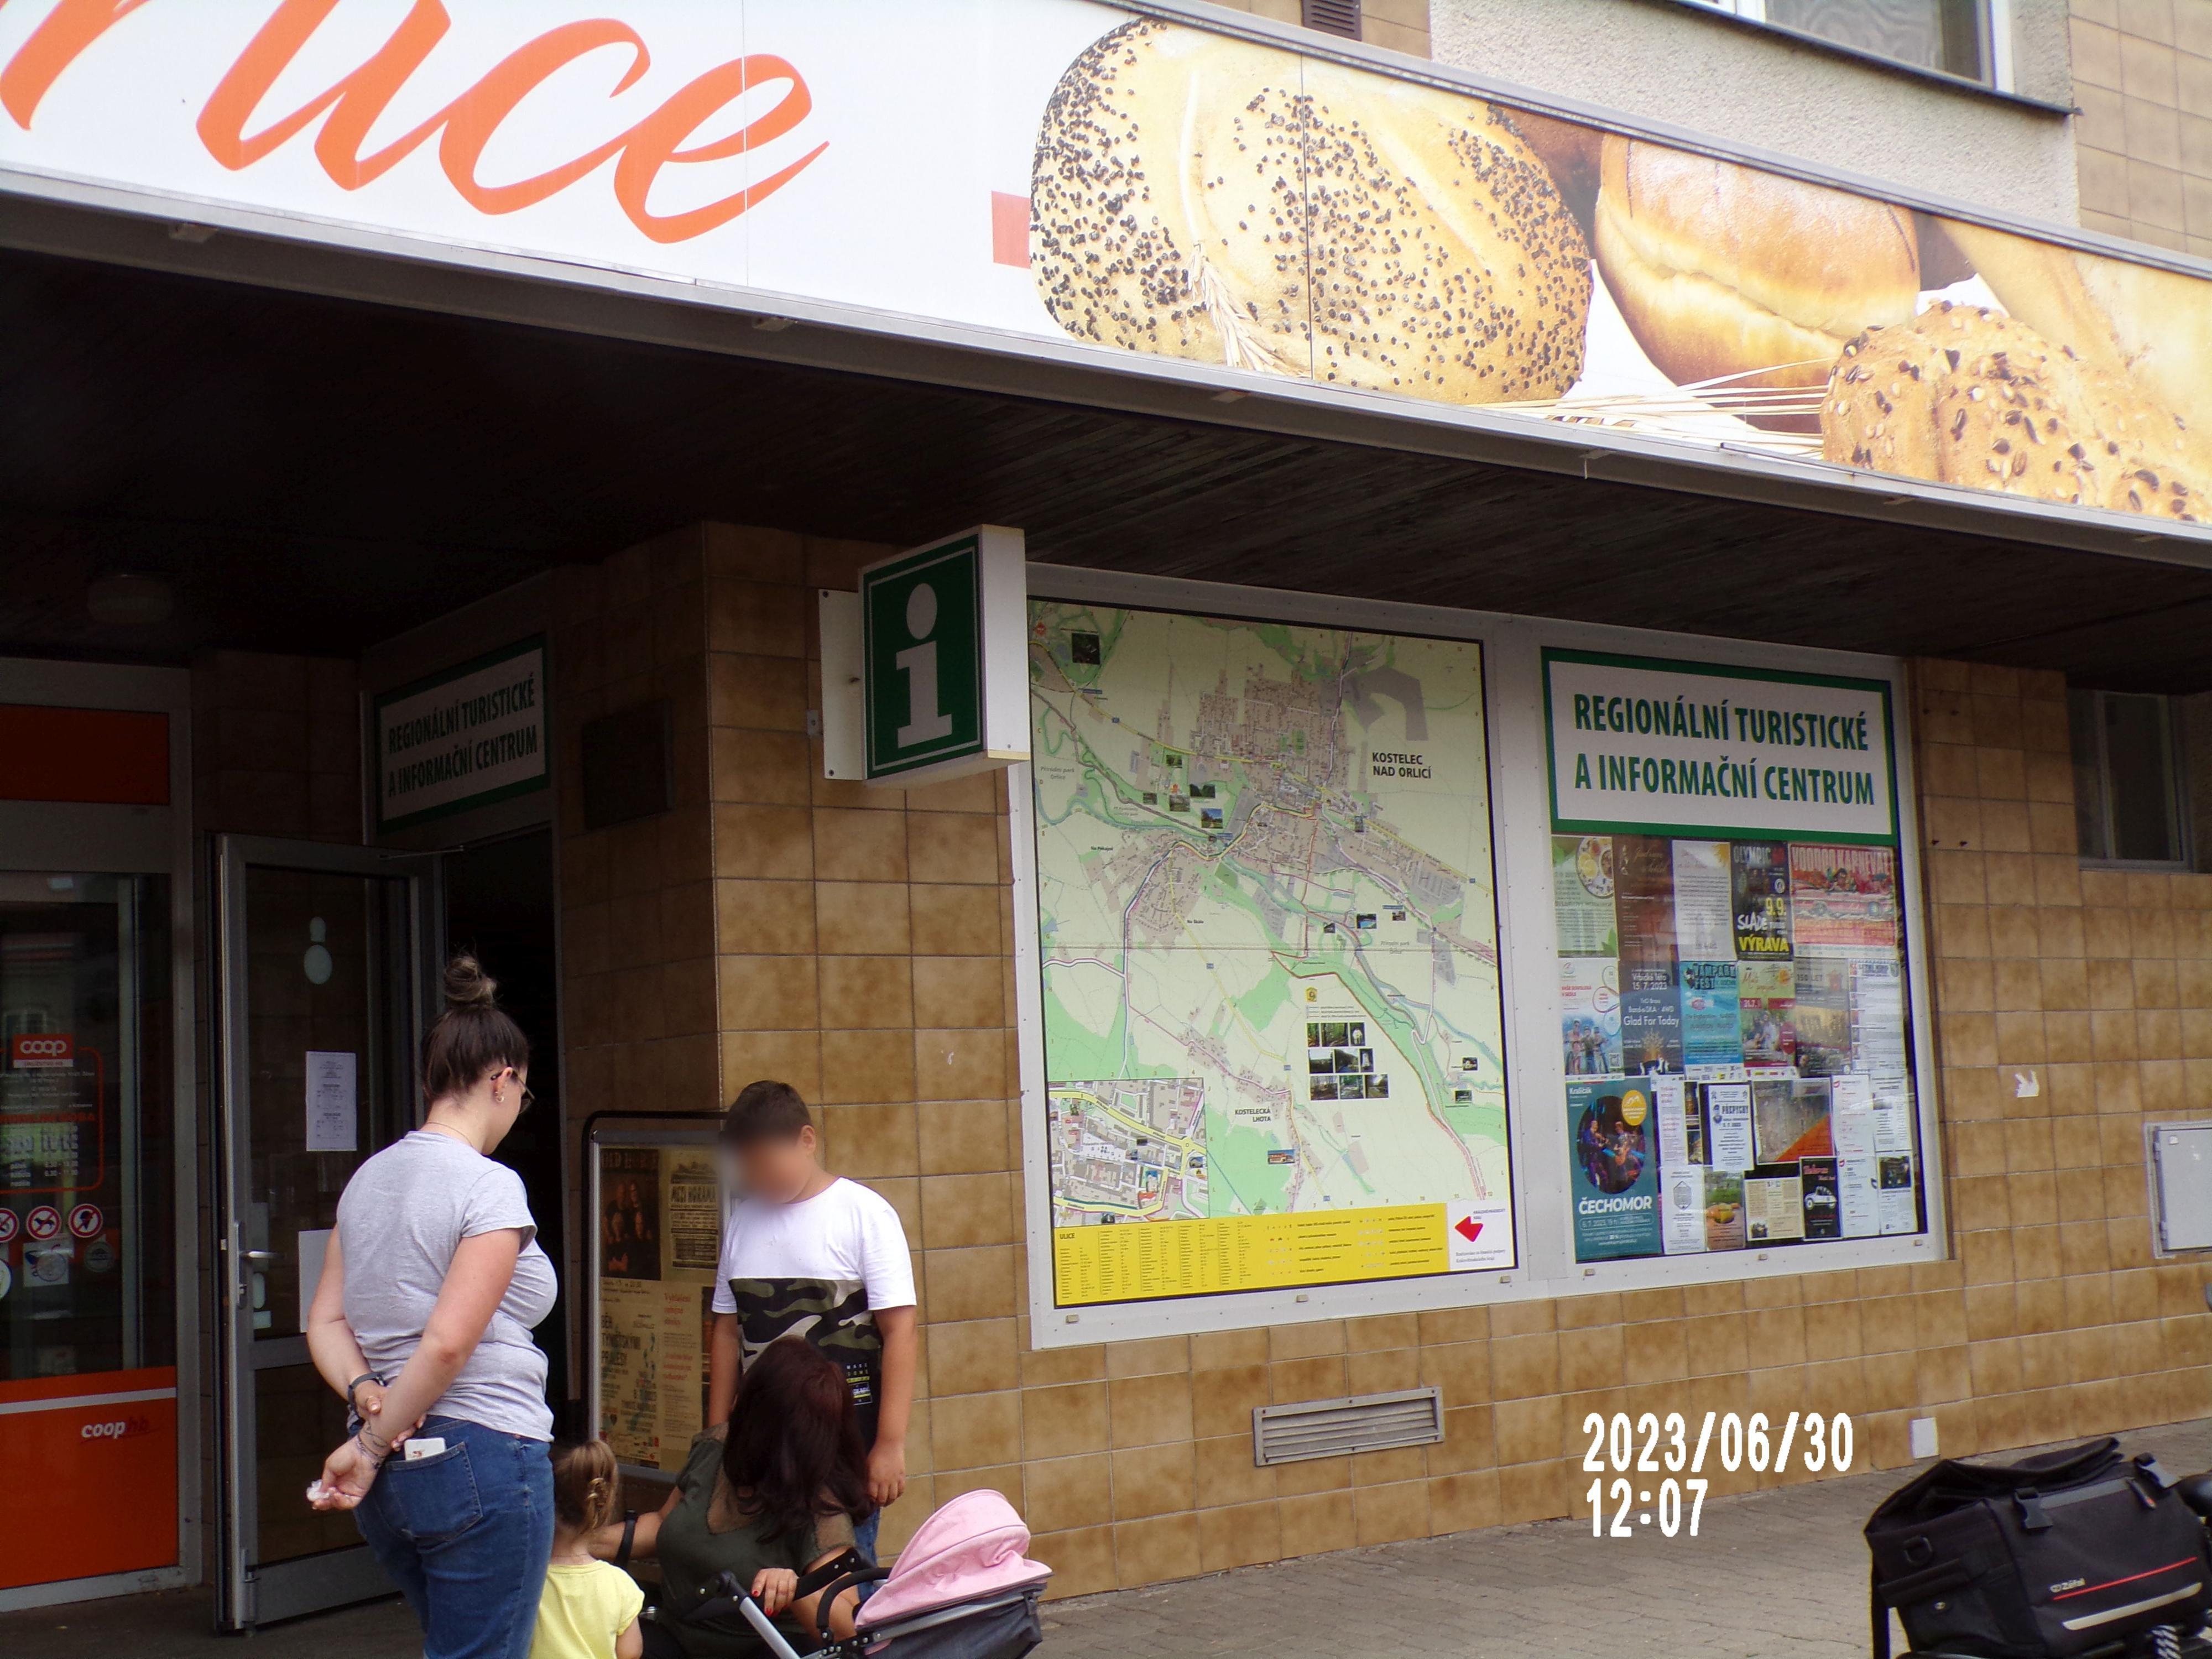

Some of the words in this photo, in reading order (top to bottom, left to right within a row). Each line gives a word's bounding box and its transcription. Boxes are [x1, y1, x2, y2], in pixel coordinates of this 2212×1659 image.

[389, 700, 460, 754] REGIONÁLNÍ
[462, 672, 535, 729] TURISTICKÉ
[1574, 693, 1728, 740] REGIONÁLNÍ
[1735, 708, 1869, 751] TURISTICKÉ
[389, 771, 397, 797] A
[399, 740, 472, 795] INFORMAČNÍ
[476, 725, 538, 770] CENTRUM
[1372, 752, 1423, 765] KOSTELEC
[1373, 765, 1396, 776] NAD
[1399, 766, 1432, 779] ORLICÍ
[1575, 753, 1592, 790] A
[1599, 755, 1757, 799] INFORMAČNÍ
[1764, 766, 1874, 805] CENTRUM
[1739, 934, 1790, 952] VÝRAVA
[1650, 982, 1667, 990] 2023
[1624, 1015, 1642, 1026] Glad
[1657, 1015, 1680, 1027] Today
[20, 1040, 67, 1057] coop
[1235, 1107, 1271, 1116] KOSTELECKÁ
[1579, 1195, 1653, 1215] ČECHOMOR
[81, 1421, 126, 1439] coop
